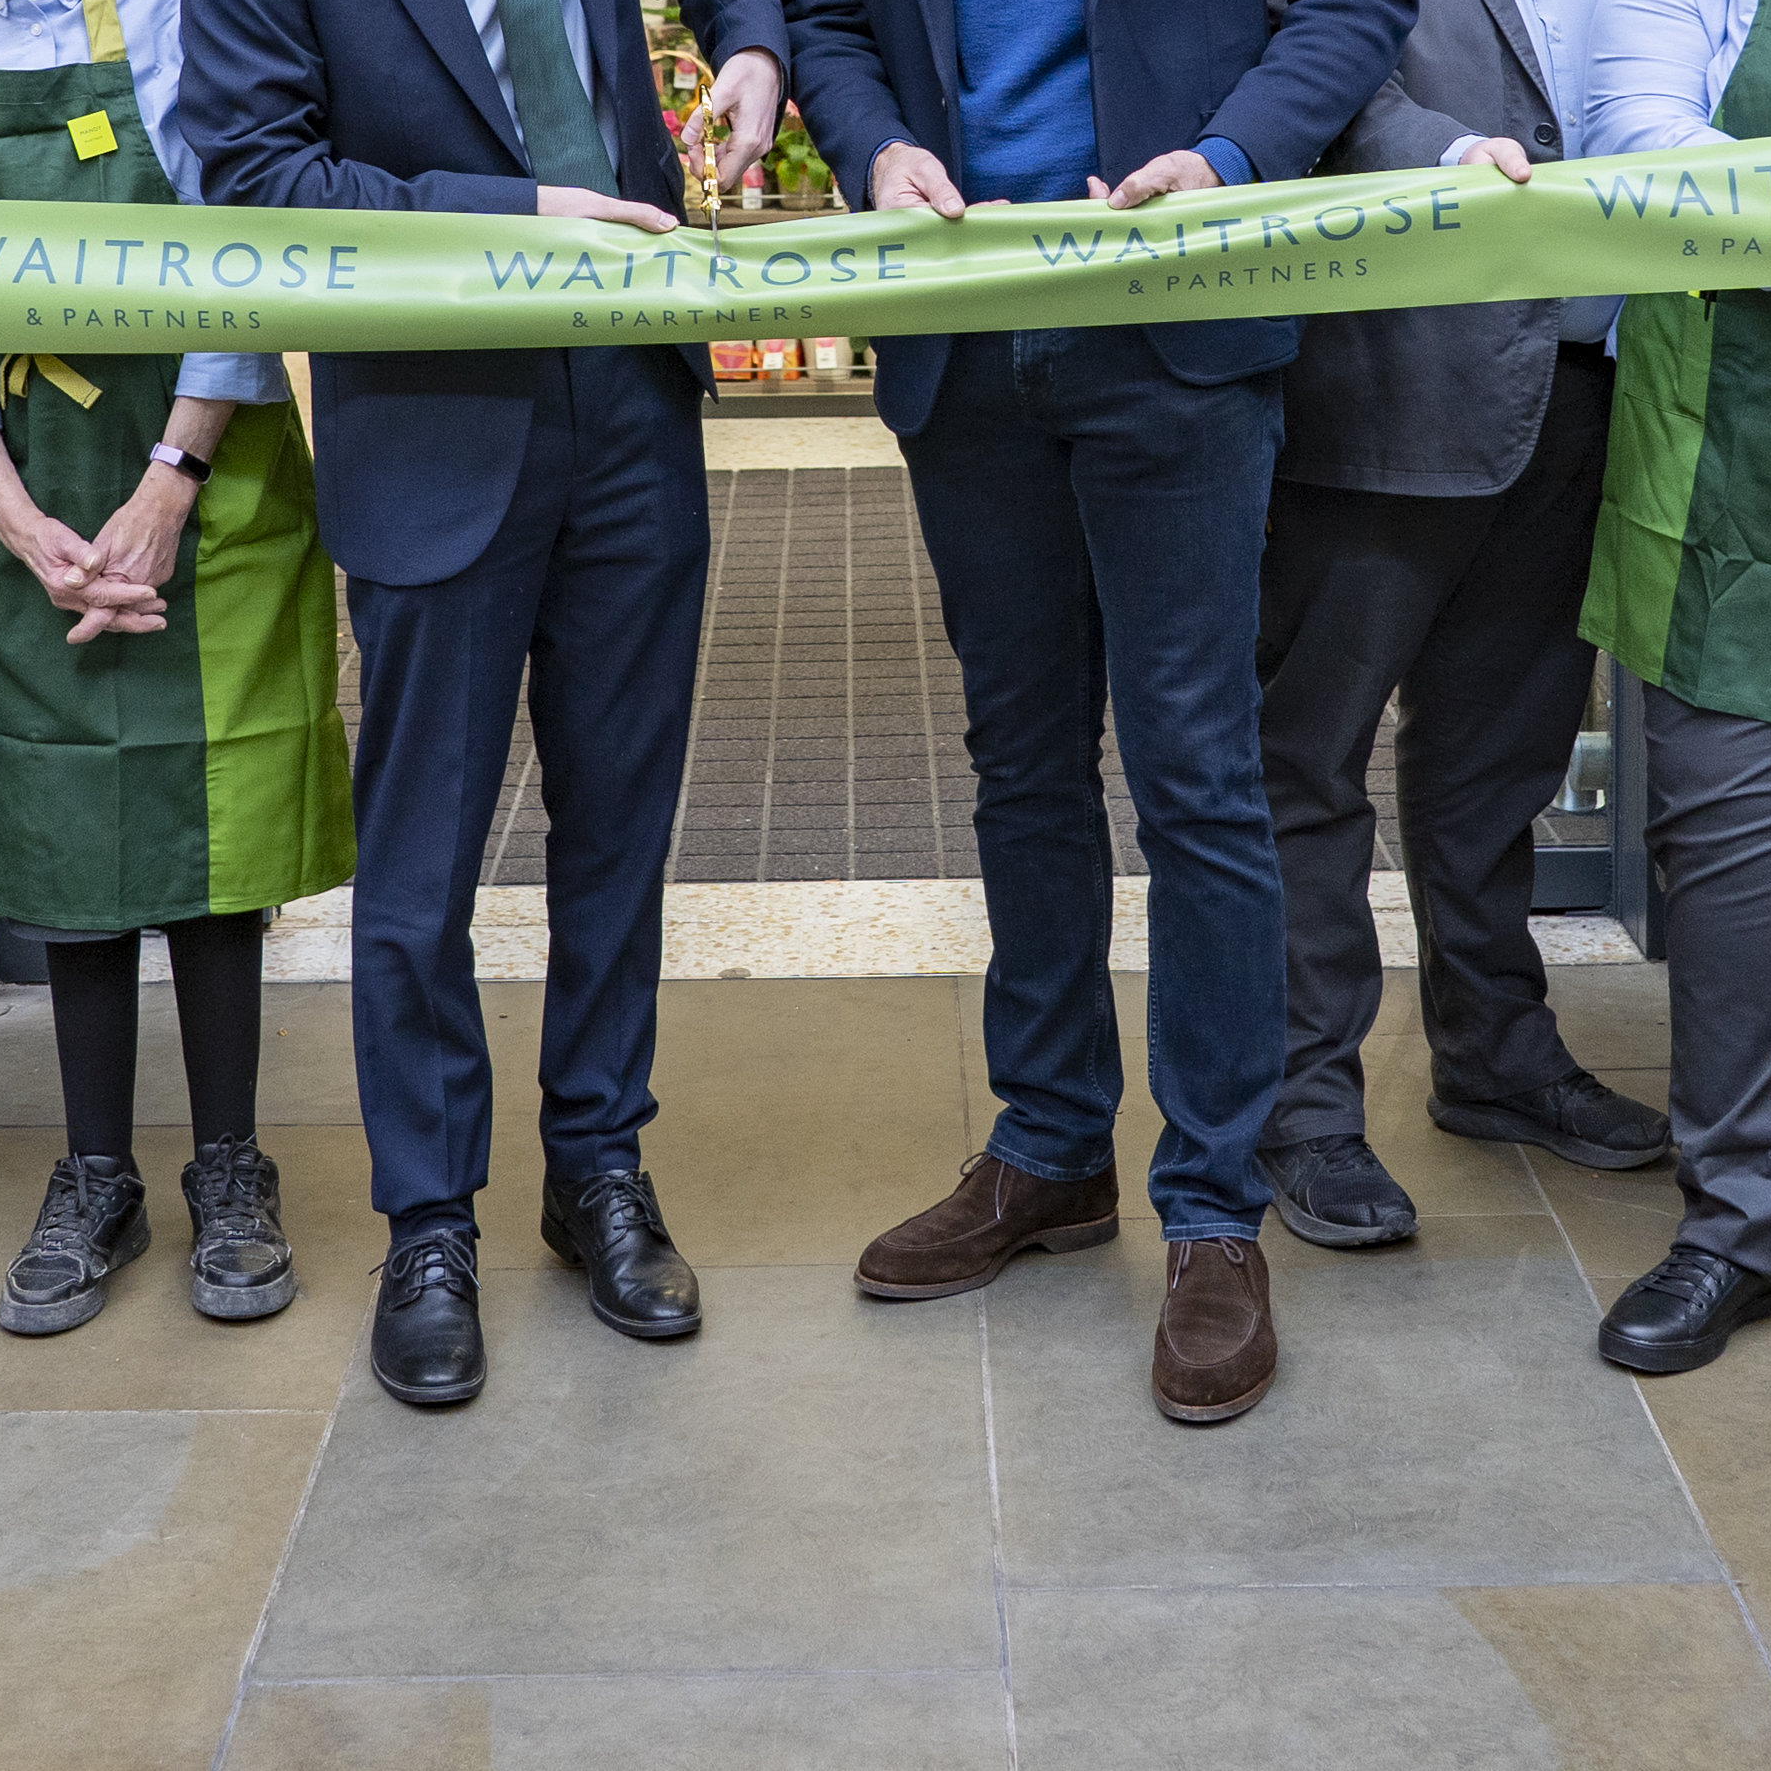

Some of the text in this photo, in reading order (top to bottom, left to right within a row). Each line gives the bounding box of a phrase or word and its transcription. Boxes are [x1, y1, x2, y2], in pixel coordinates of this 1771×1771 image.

[1032, 185, 1461, 268] WAITROSE
[1682, 239, 1700, 257] &
[485, 243, 906, 291] WAITROSE
[1129, 258, 1368, 296] & PARTNERS
[26, 307, 262, 330] & PARTNERS
[572, 305, 813, 329] & PARTNERS
